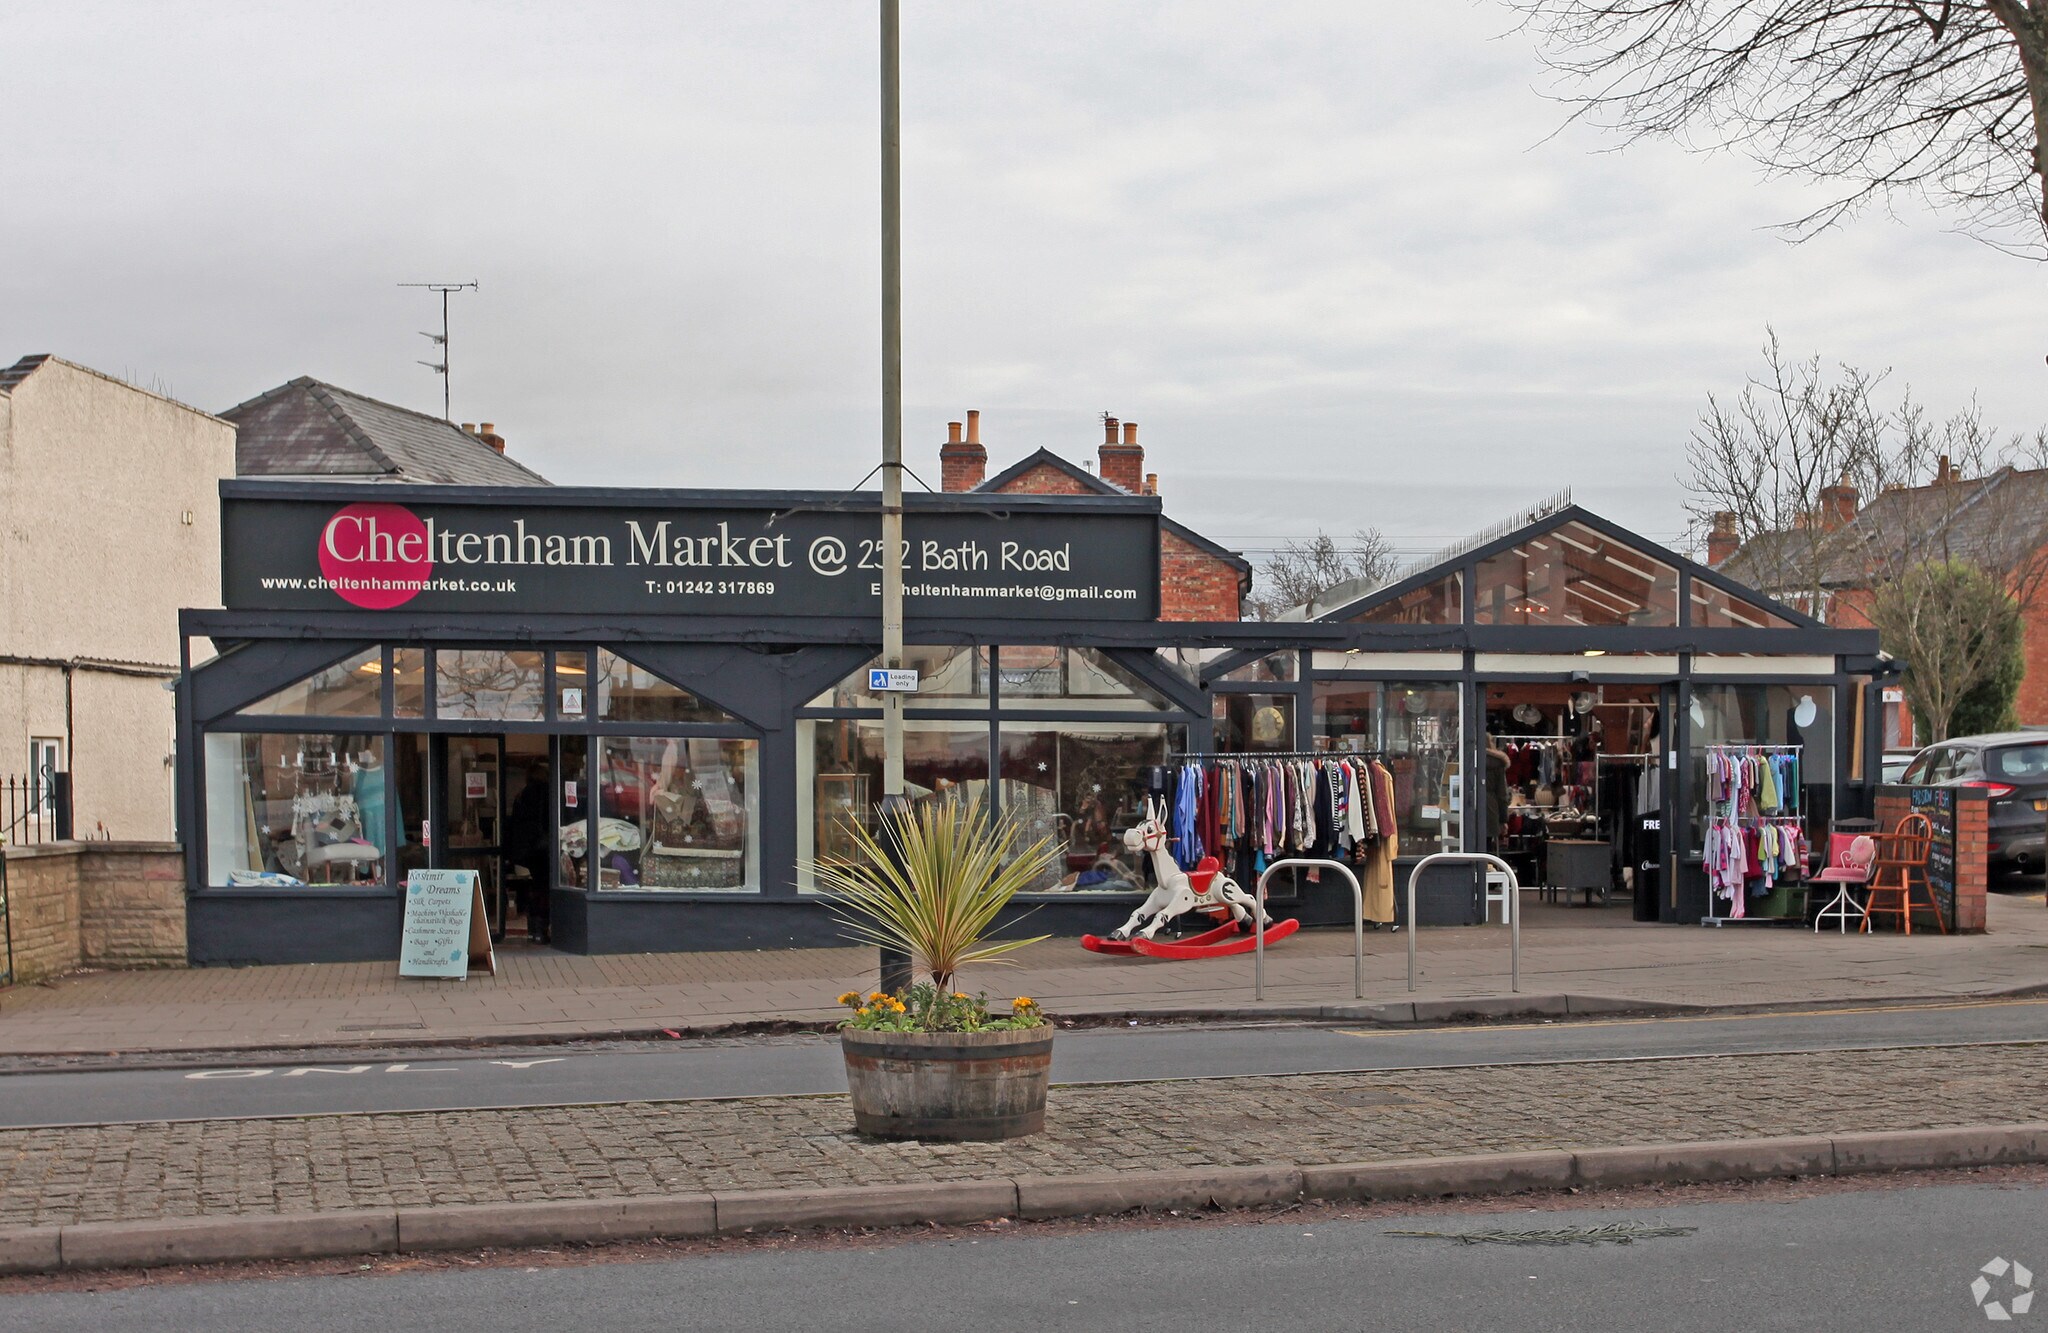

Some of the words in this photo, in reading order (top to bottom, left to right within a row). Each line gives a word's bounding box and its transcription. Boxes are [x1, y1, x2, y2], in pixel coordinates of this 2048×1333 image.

[325, 515, 615, 566] Cheltenham
[624, 519, 793, 568] Market
[808, 535, 848, 577] @
[921, 540, 988, 572] Bath
[1001, 541, 1070, 572] Road
[260, 576, 517, 593] www.cheltenhammarket.co.uk
[645, 580, 661, 594] T:
[666, 580, 714, 594] 01242
[717, 580, 775, 595] 317869
[902, 582, 1137, 602] heltenhammarket@gmail.com
[890, 673, 916, 681] Loading
[409, 870, 445, 881] Kashmir
[426, 884, 461, 895] Dreams
[412, 898, 425, 906] Silk
[428, 898, 451, 908] Carpets
[411, 909, 437, 917] Machine
[414, 938, 429, 947] Bags
[437, 937, 453, 946] Gifts
[423, 948, 436, 956] and
[412, 959, 448, 968] Handicrafts
[185, 1058, 565, 1080] ONLY
